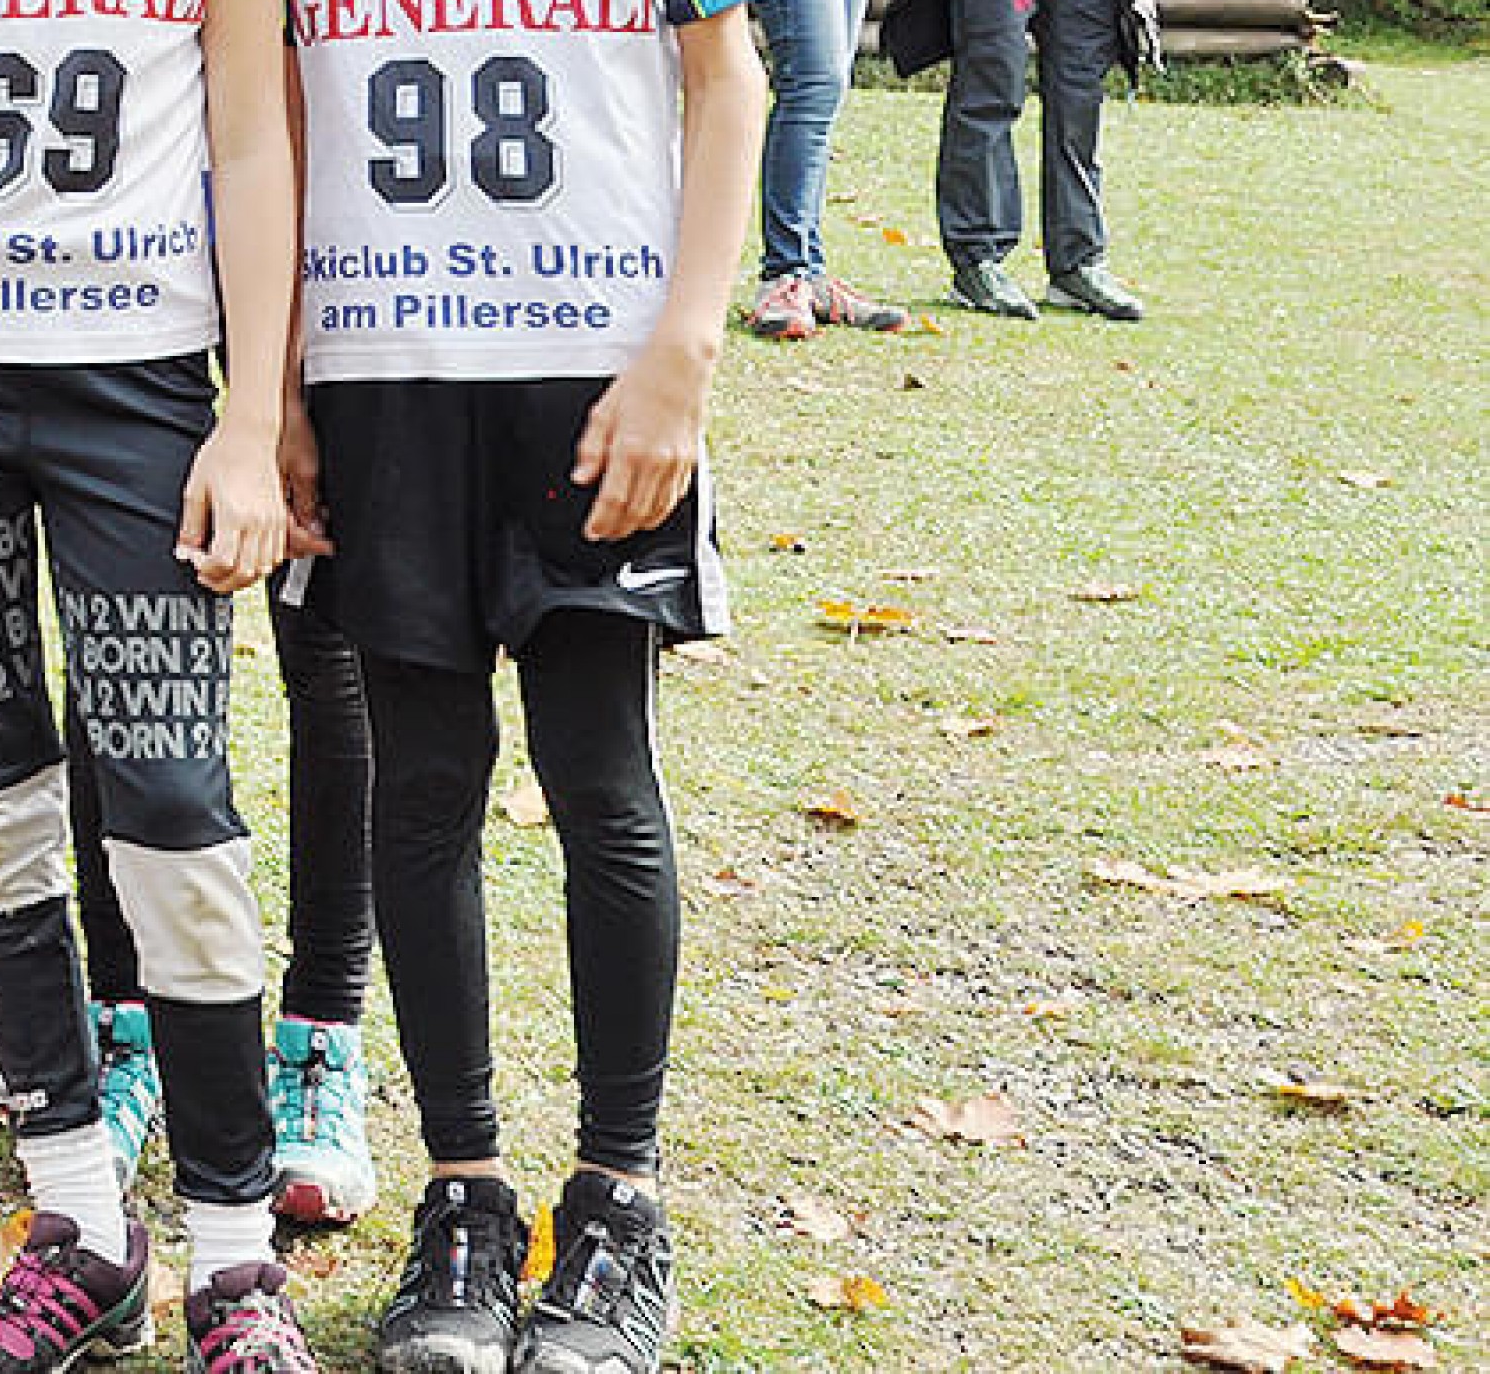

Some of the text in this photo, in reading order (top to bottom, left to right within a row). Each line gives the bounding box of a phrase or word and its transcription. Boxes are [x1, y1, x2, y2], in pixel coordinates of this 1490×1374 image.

[367, 56, 555, 204] 98
[6, 230, 74, 264] St.
[446, 242, 512, 277] St.
[532, 244, 665, 279] Ulrich
[320, 294, 613, 331] am Pillersee
[115, 593, 208, 632] WIN
[83, 635, 182, 674] BORN
[189, 638, 213, 674] 2
[121, 678, 210, 717] WIN
